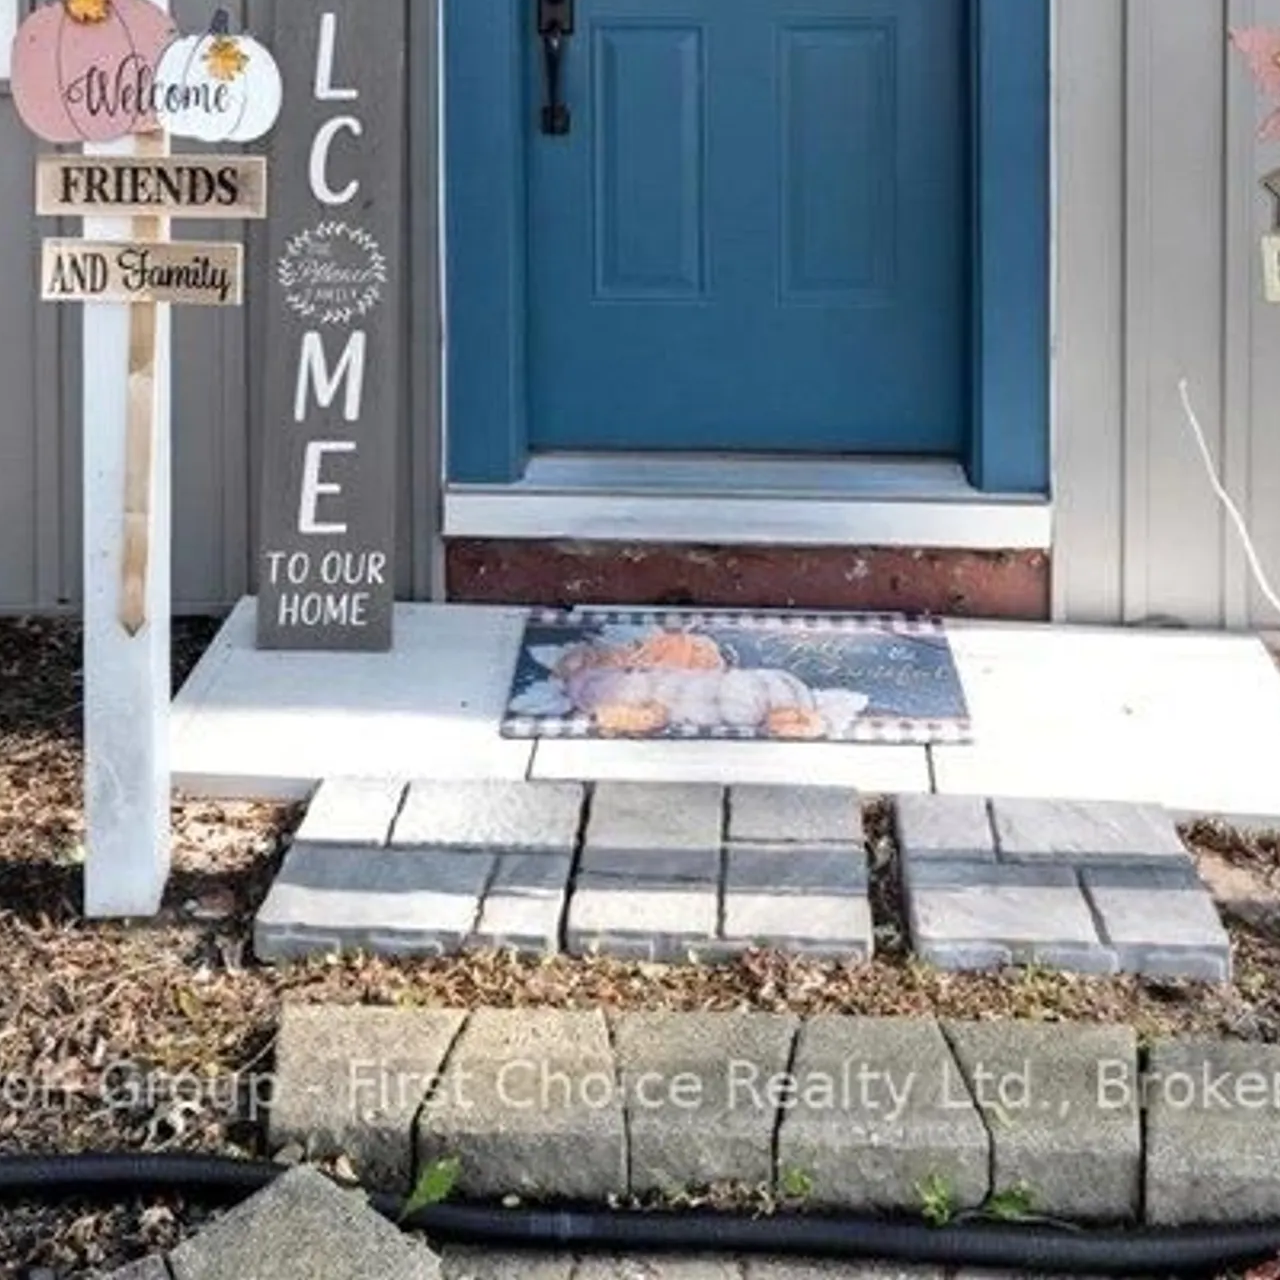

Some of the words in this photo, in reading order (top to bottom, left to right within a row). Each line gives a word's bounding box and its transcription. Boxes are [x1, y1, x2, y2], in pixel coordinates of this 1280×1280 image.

[66, 53, 229, 116] Welcome
[58, 165, 238, 206] FRIENDS
[49, 251, 109, 294] AND
[116, 248, 232, 301] Family
[265, 550, 310, 585] TO
[321, 549, 386, 585] OUR
[278, 592, 371, 626] HOME
